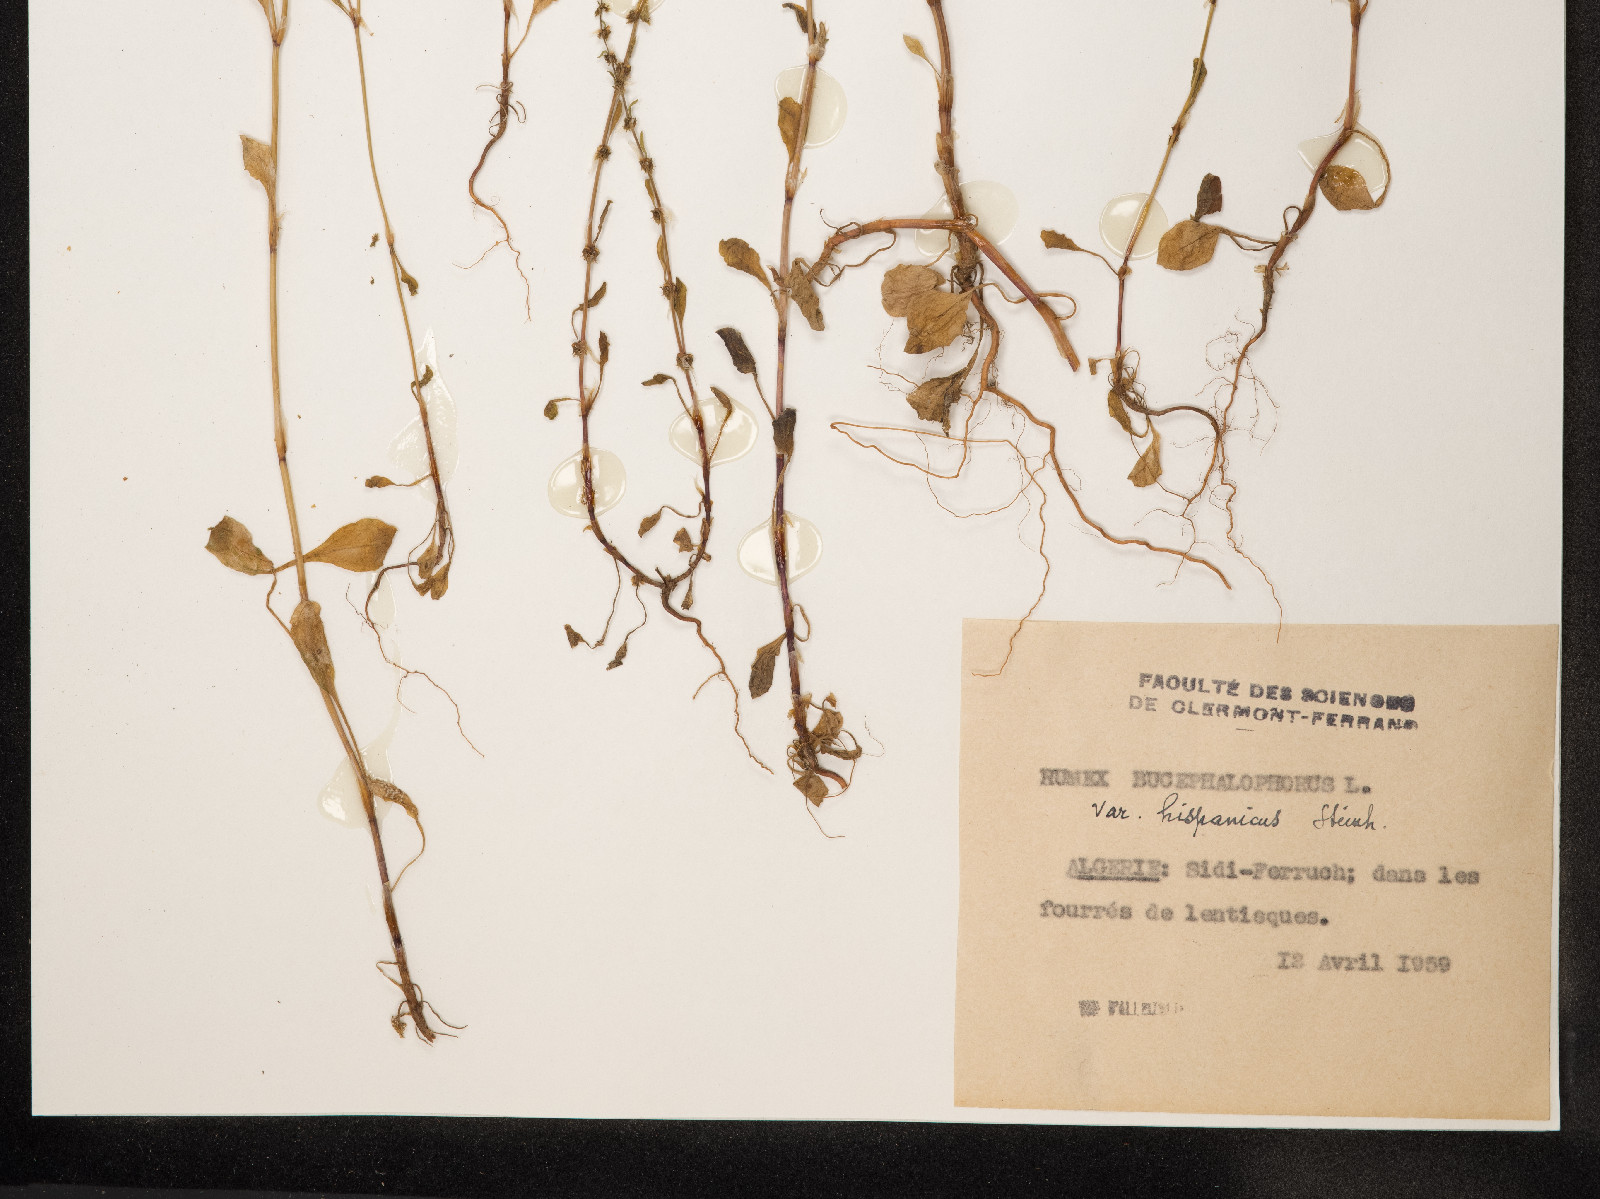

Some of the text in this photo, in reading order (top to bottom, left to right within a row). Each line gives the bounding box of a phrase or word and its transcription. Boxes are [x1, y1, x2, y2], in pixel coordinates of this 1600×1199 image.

[1250, 683, 1292, 701] DES
[1129, 696, 1158, 712] DE
[1344, 775, 1372, 794] L.
[1157, 793, 1280, 837] hispanicus
[1186, 861, 1355, 885] Sidi-Ferruch;
[1372, 865, 1426, 884] dans
[1439, 867, 1480, 885] les
[1039, 899, 1329, 928] fourrés de lentisques.
[1317, 952, 1384, 972] Avril
